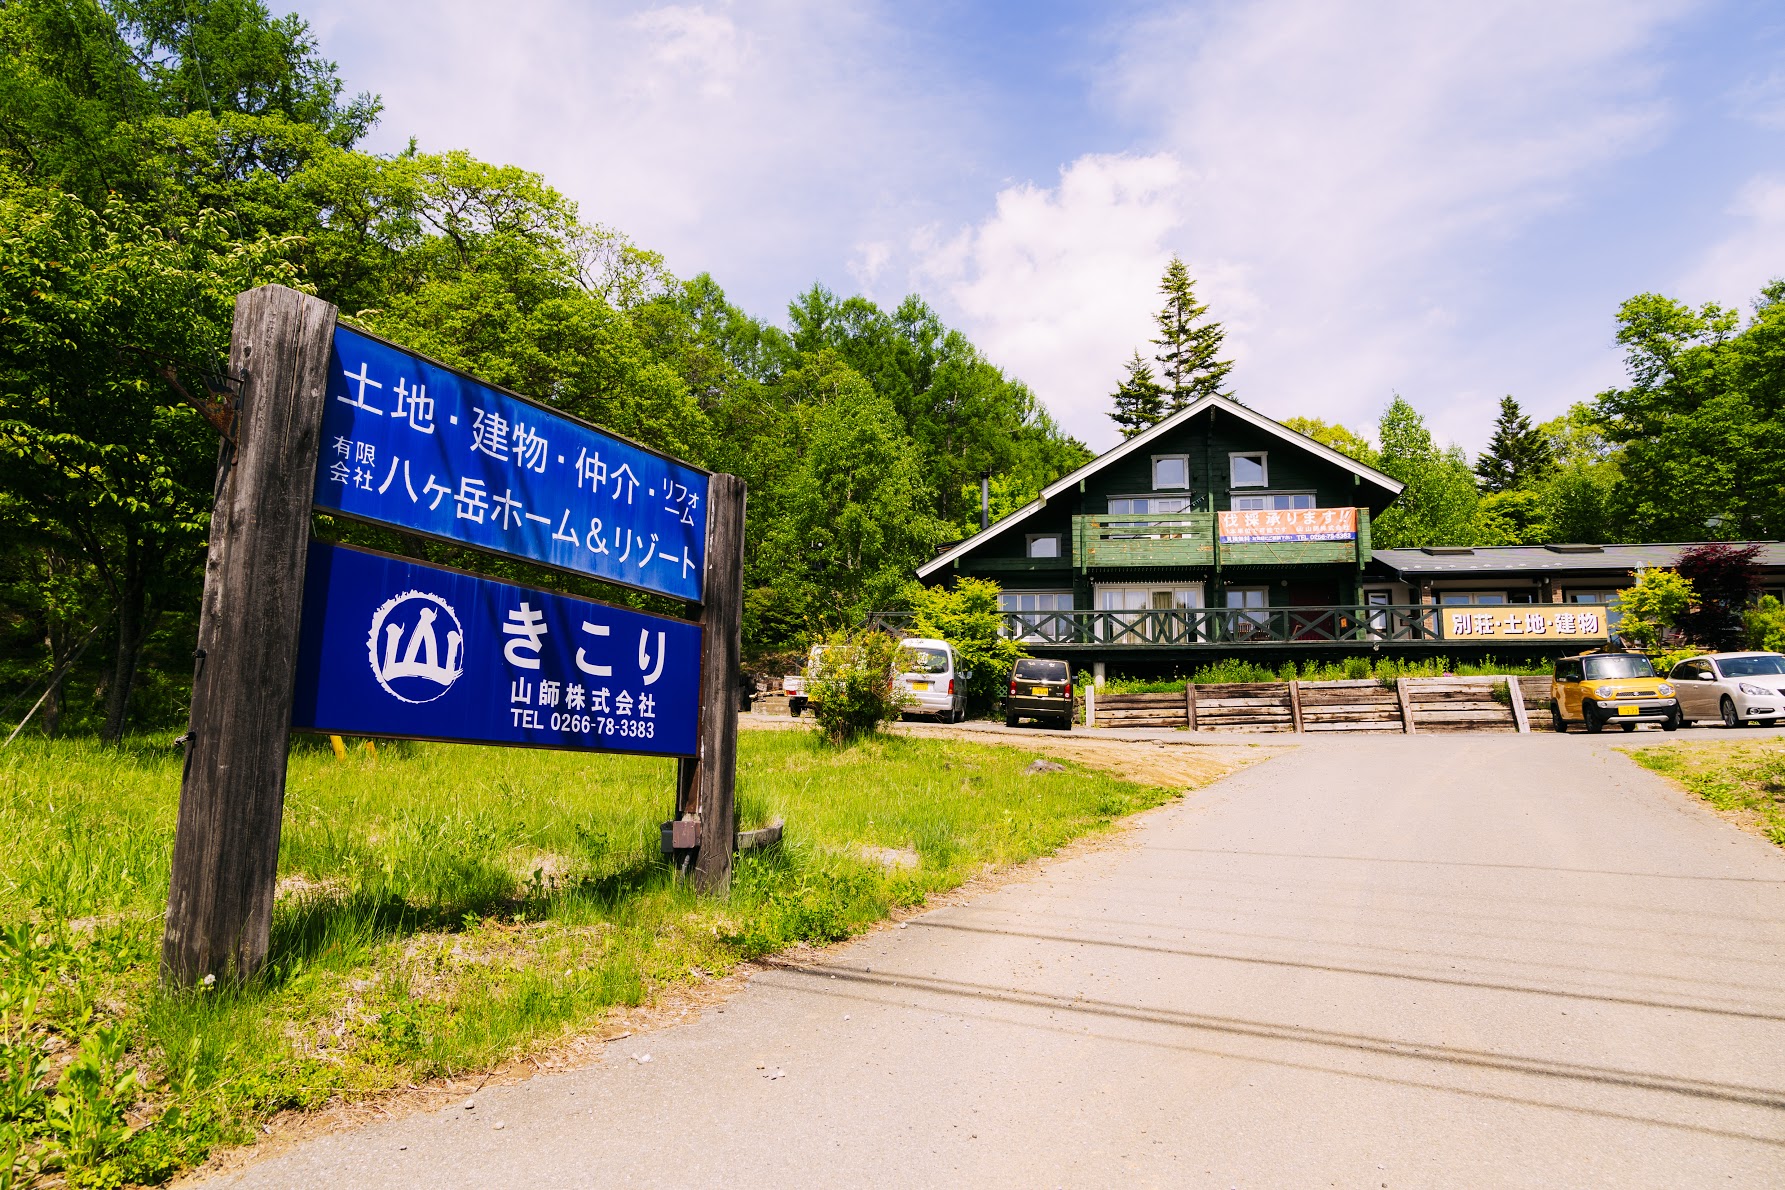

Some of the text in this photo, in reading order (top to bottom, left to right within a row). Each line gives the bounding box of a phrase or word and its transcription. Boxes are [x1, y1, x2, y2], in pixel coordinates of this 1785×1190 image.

[332, 435, 376, 468] 有限
[329, 460, 374, 492] 会社
[502, 601, 667, 687] きこり
[510, 676, 656, 719] 山師株式会社
[510, 708, 656, 739] TEL 0266-78-3383
